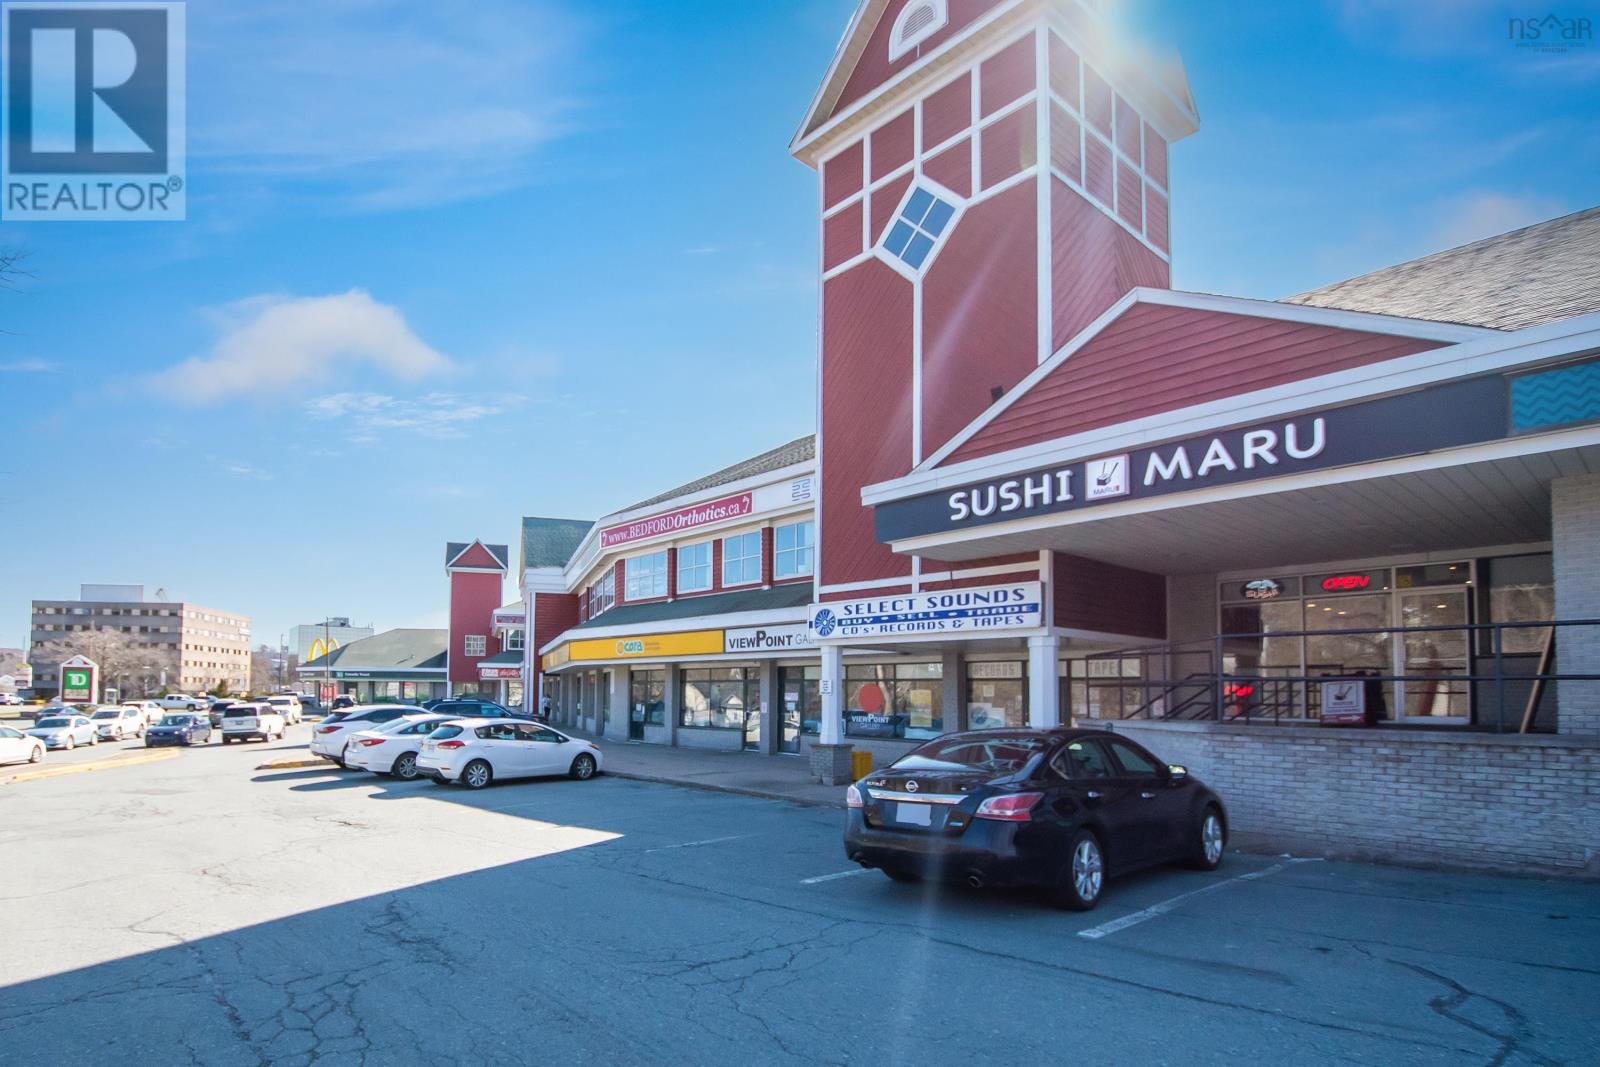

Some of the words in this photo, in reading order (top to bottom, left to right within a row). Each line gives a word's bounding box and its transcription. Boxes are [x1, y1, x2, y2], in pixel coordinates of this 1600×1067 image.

[949, 470, 1073, 521] SUSHI
[1143, 418, 1326, 486] MARU
[1322, 575, 1370, 590] OPEN
[844, 598, 917, 616] SELECT
[928, 588, 1025, 609] SOUNDS
[841, 617, 873, 626] BUY
[896, 611, 936, 621] SELL
[965, 604, 1033, 616] TRADE
[880, 620, 945, 633] RECORDS
[973, 615, 1025, 627] TAPES
[67, 673, 87, 686] TD
